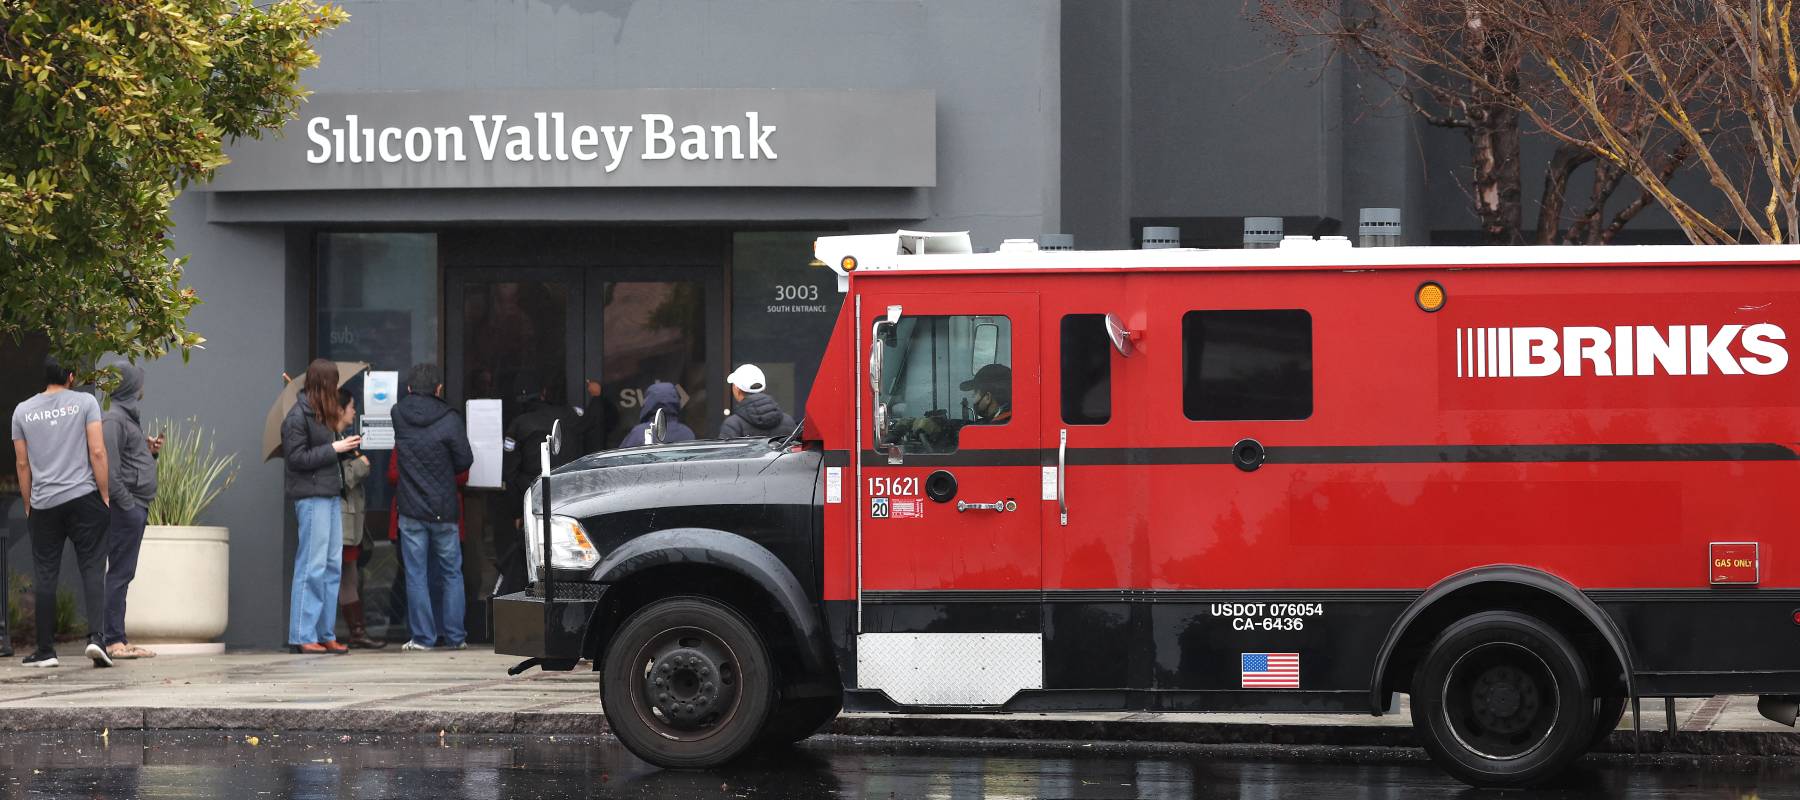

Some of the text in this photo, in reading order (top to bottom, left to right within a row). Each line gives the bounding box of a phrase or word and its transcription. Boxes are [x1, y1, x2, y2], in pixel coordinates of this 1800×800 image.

[469, 112, 633, 173] Valley
[641, 111, 778, 161] Bank
[775, 285, 818, 301] 3003
[767, 305, 827, 313] SOUTH ENTRANCE
[1512, 323, 1789, 377] BRINKS
[868, 477, 919, 496] 151621
[872, 503, 888, 517] 20
[1714, 559, 1752, 568] GAS ONLY
[1211, 603, 1323, 617] USDOT 076054
[1232, 617, 1304, 631] CA-6436
